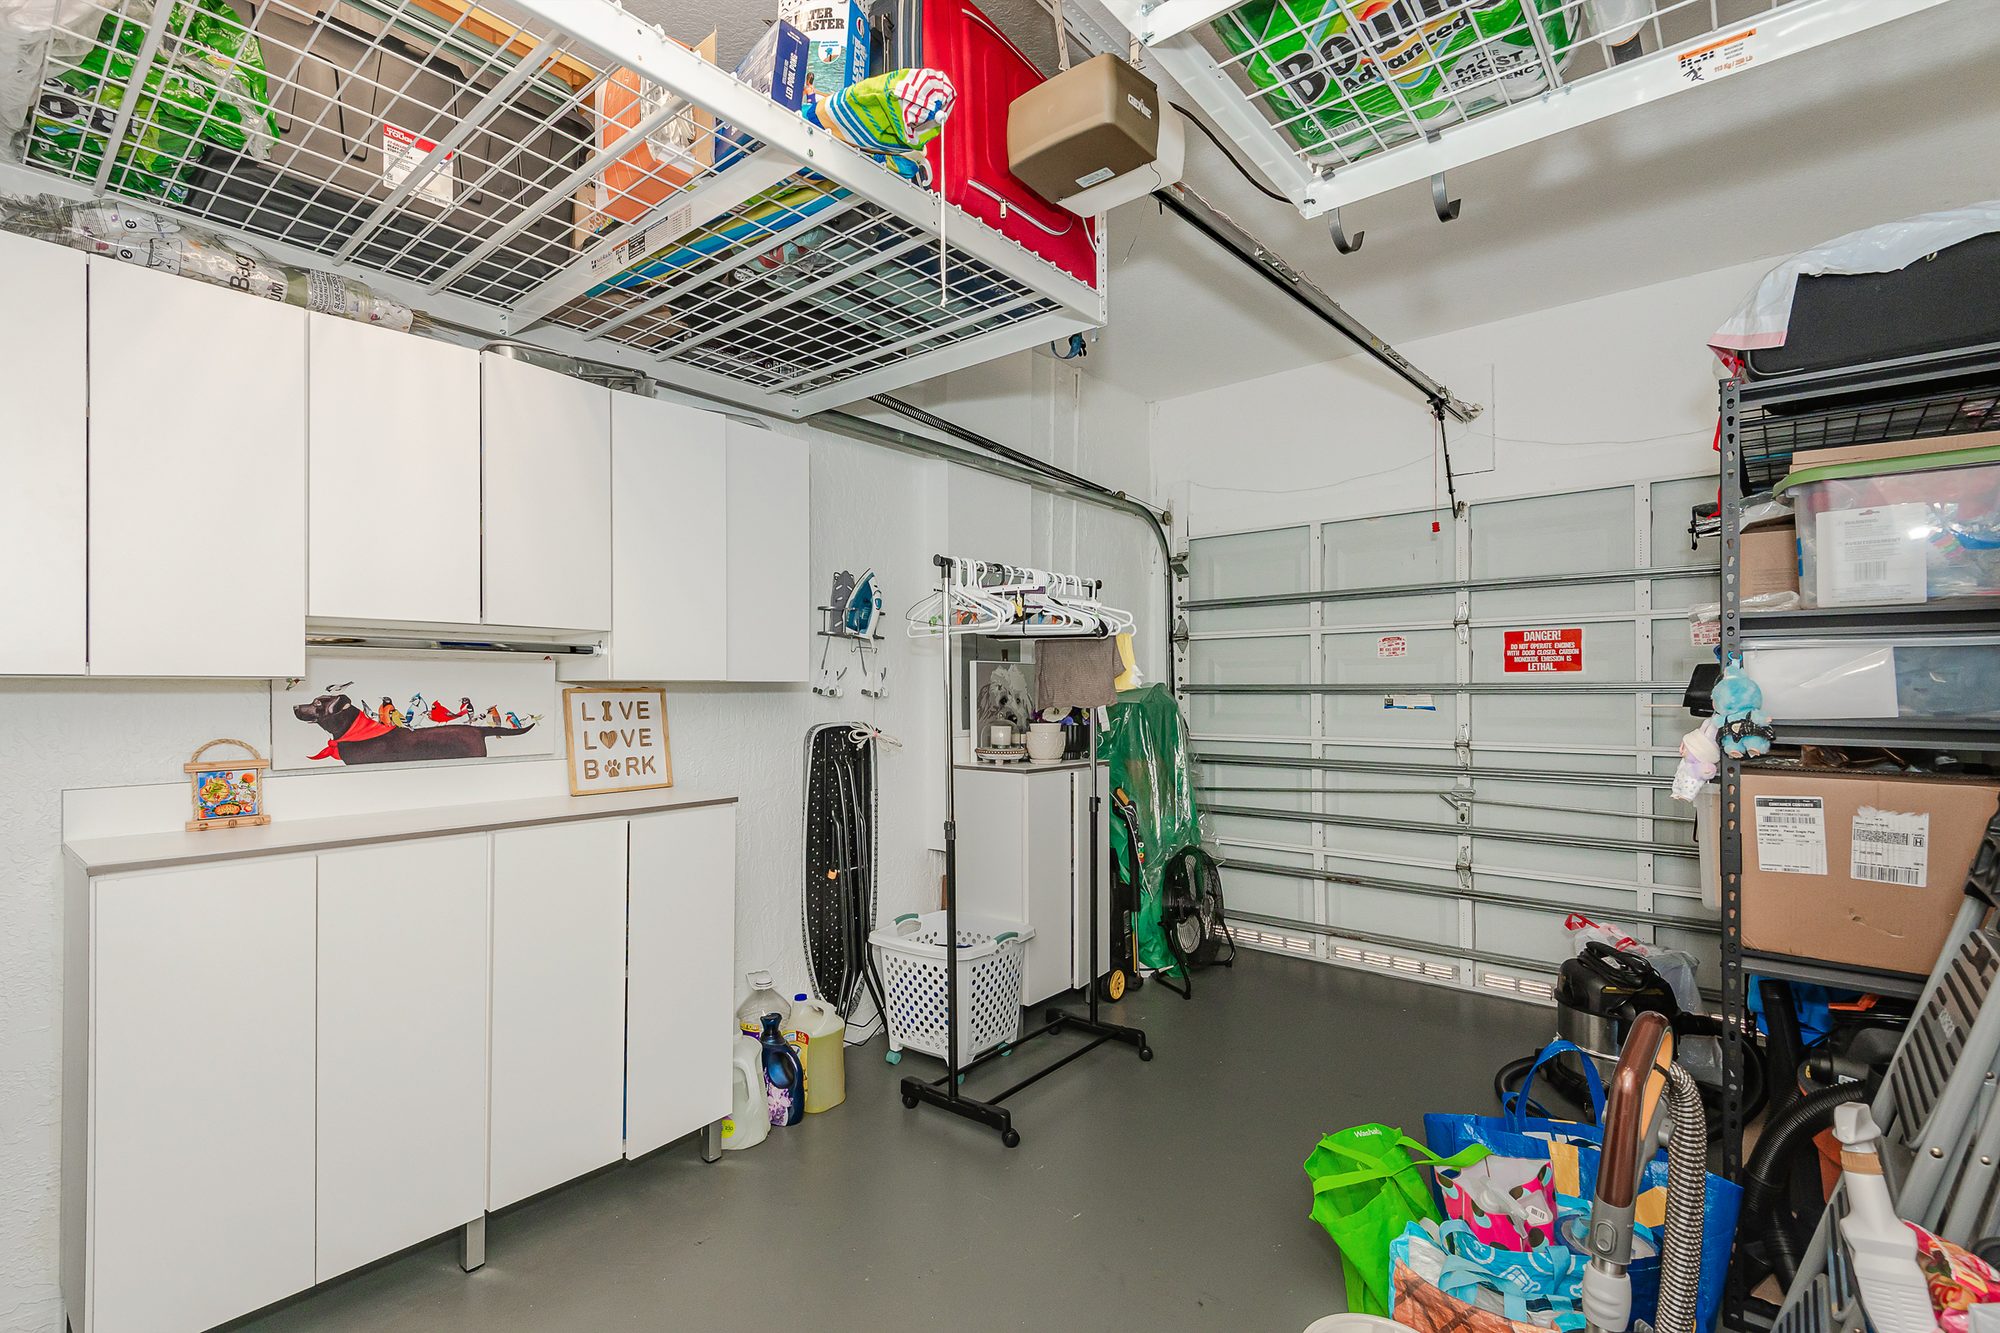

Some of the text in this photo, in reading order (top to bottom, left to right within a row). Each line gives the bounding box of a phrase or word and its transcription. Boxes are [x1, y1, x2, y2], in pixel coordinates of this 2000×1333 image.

[1455, 50, 1523, 78] MOST
[229, 253, 257, 291] Bag
[1524, 630, 1561, 642] DANGER!
[1527, 662, 1557, 671] LETHAL.
